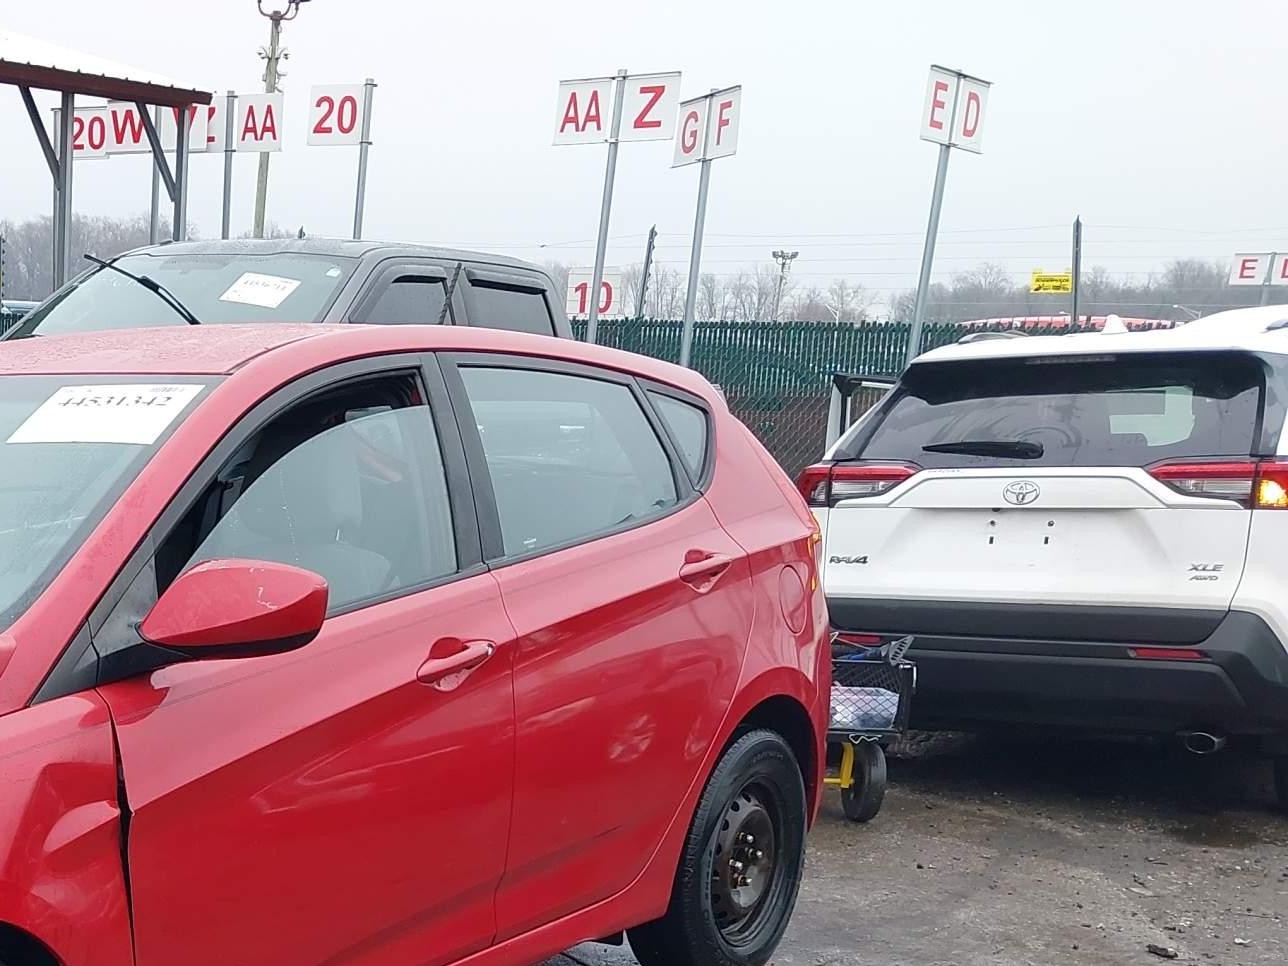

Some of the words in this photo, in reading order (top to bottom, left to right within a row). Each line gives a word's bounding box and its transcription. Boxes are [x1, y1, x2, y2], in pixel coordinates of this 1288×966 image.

[241, 104, 278, 142] AA
[312, 95, 358, 135] 20
[560, 90, 602, 133] AA
[633, 85, 666, 128] Z
[716, 100, 733, 146] F
[929, 82, 949, 130] E
[963, 91, 981, 138] D
[72, 116, 107, 151] 20
[111, 109, 146, 144] W
[681, 111, 699, 154] G
[1238, 258, 1259, 279] E
[575, 281, 613, 315] 10
[1187, 563, 1224, 572] XLE
